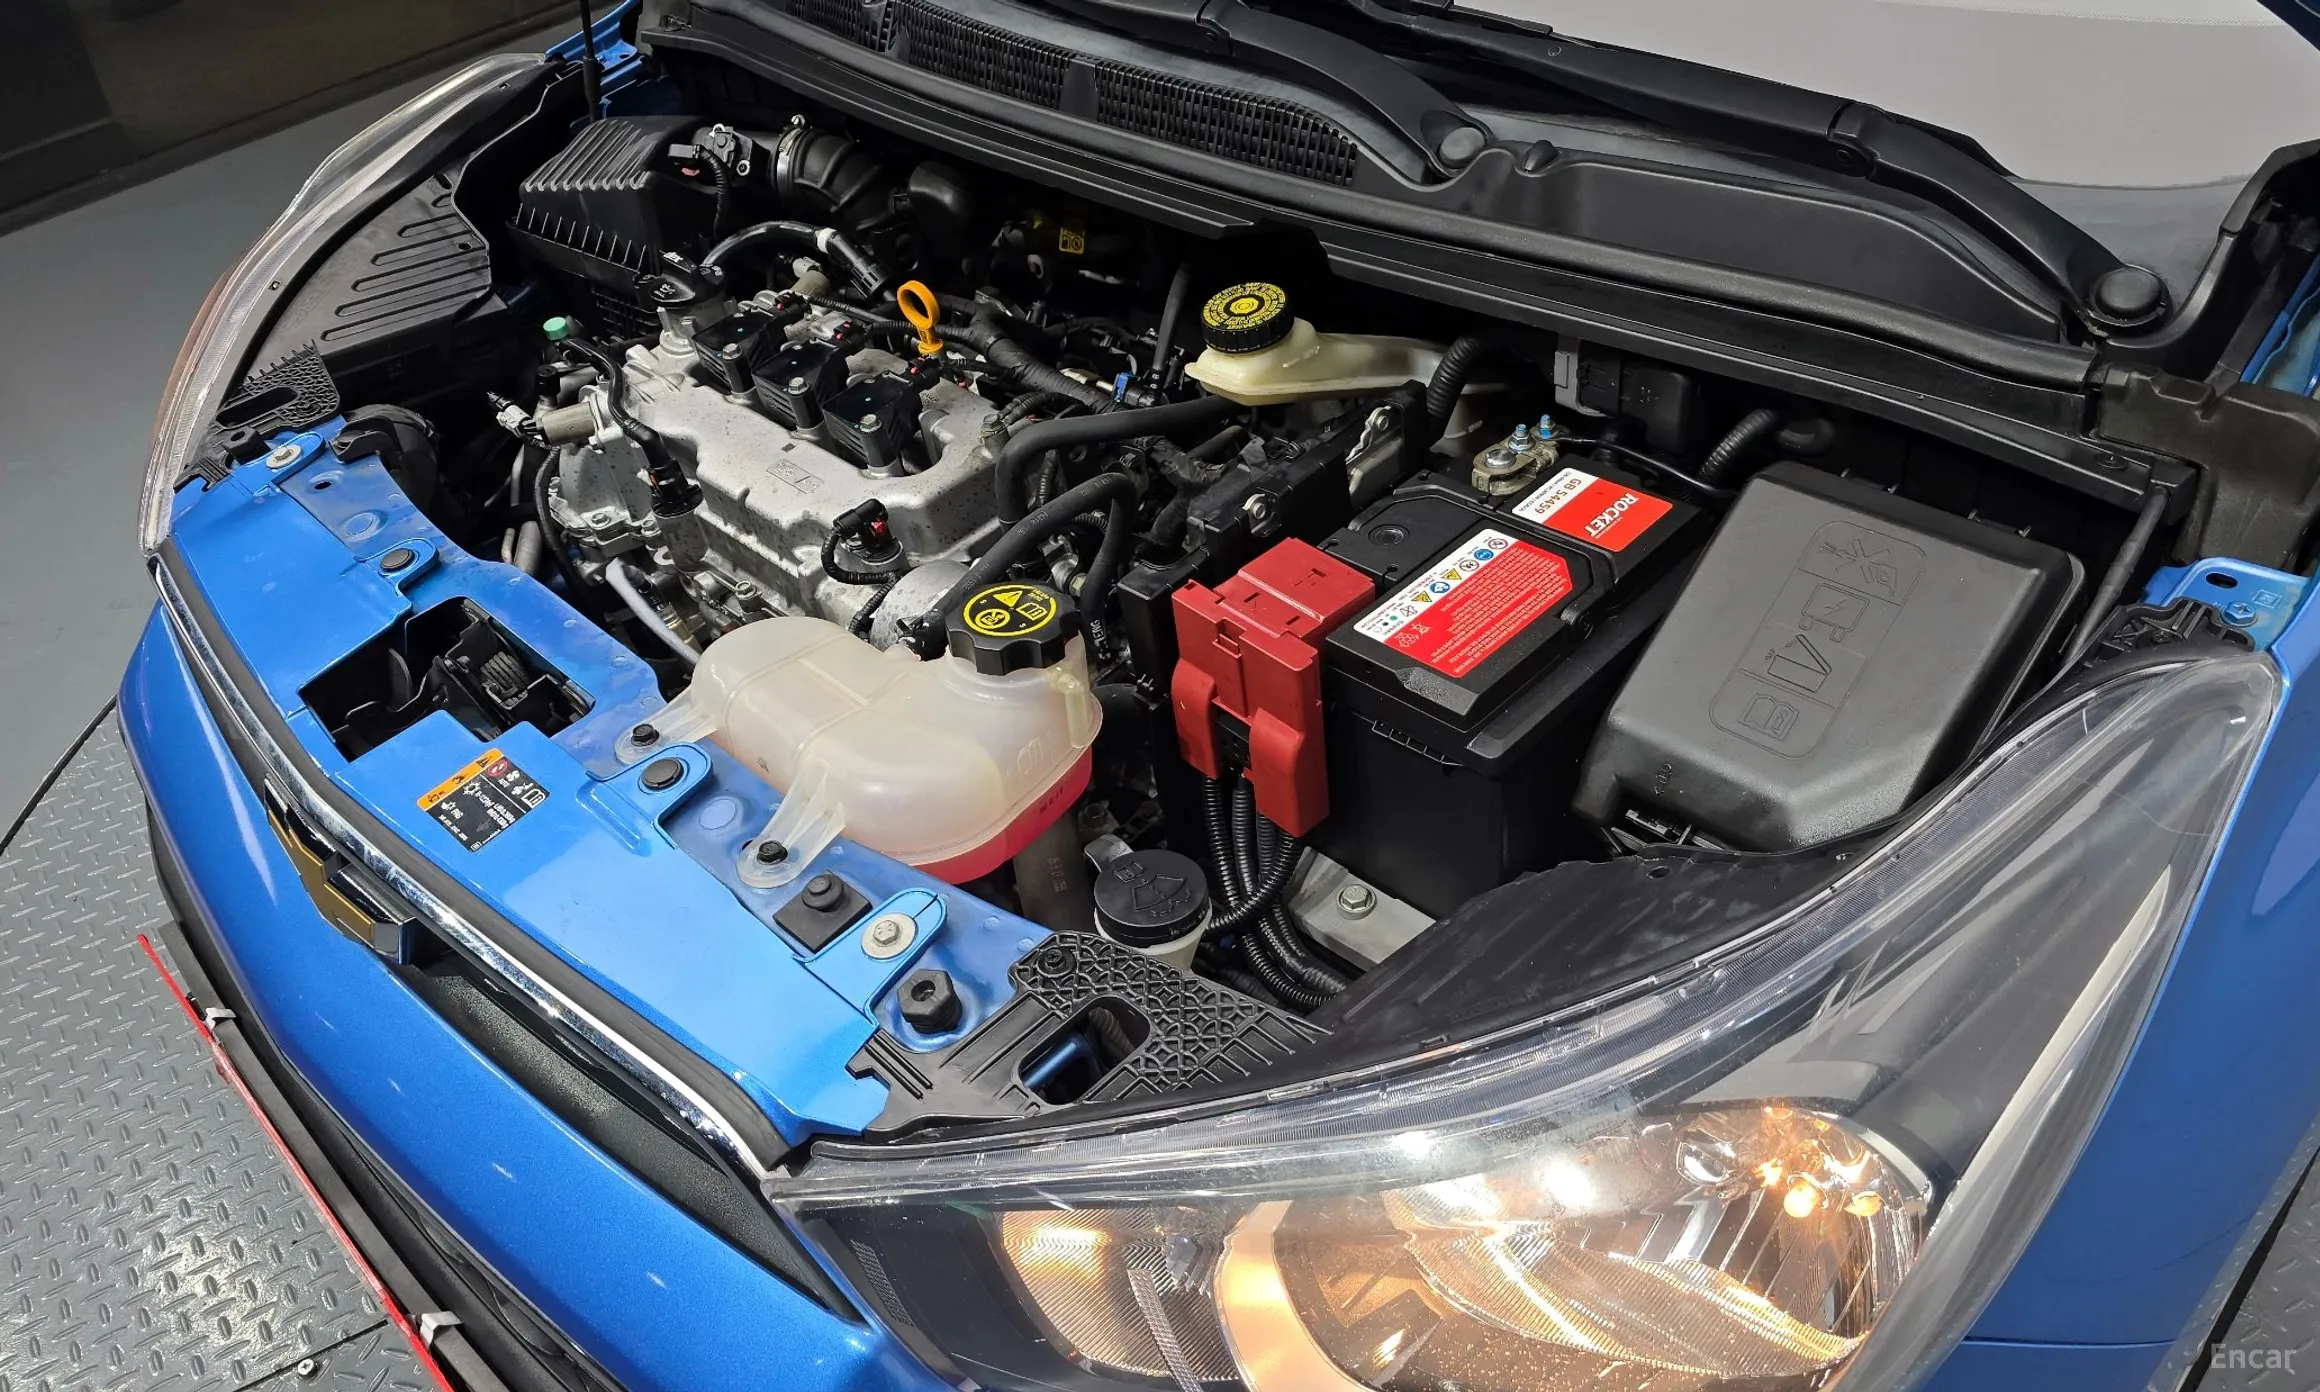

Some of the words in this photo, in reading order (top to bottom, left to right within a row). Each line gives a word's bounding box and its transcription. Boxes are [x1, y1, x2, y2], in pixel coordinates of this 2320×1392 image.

[1563, 478, 1582, 491] GB
[1535, 489, 1567, 514] 54459
[1585, 493, 1640, 537] ROCKET
